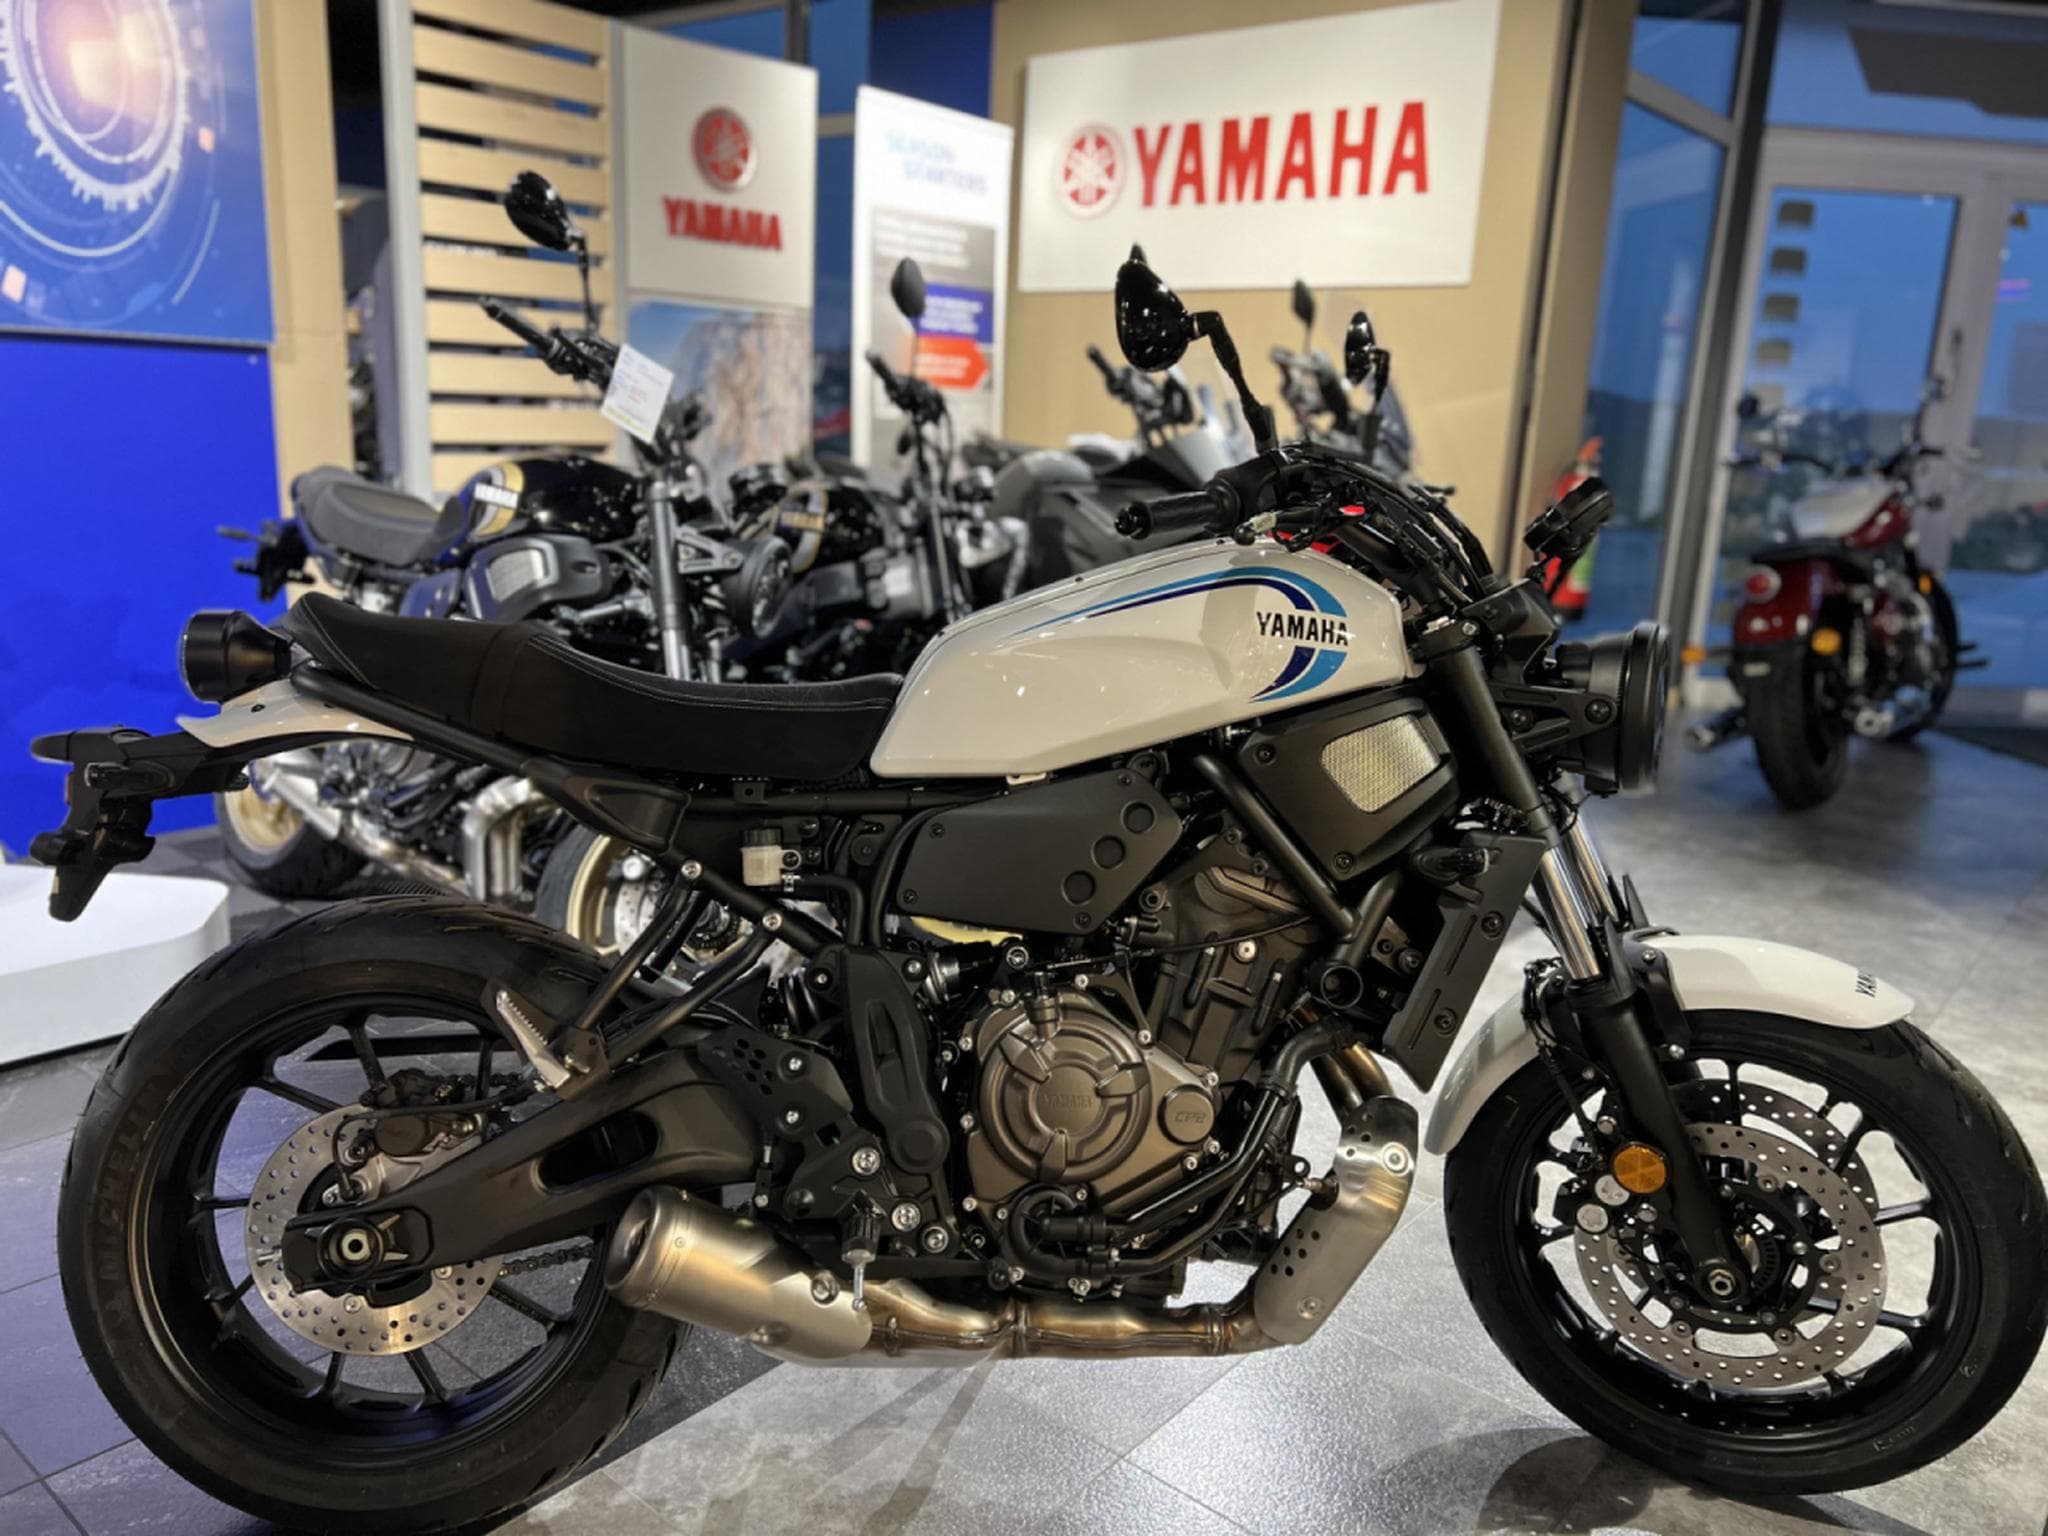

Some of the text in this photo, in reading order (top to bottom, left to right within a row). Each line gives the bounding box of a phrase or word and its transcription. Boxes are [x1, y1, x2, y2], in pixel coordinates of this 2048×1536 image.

[1133, 100, 1429, 208] YAMAHA
[662, 195, 783, 251] YAMAHA
[1256, 611, 1349, 646] YAMAHA
